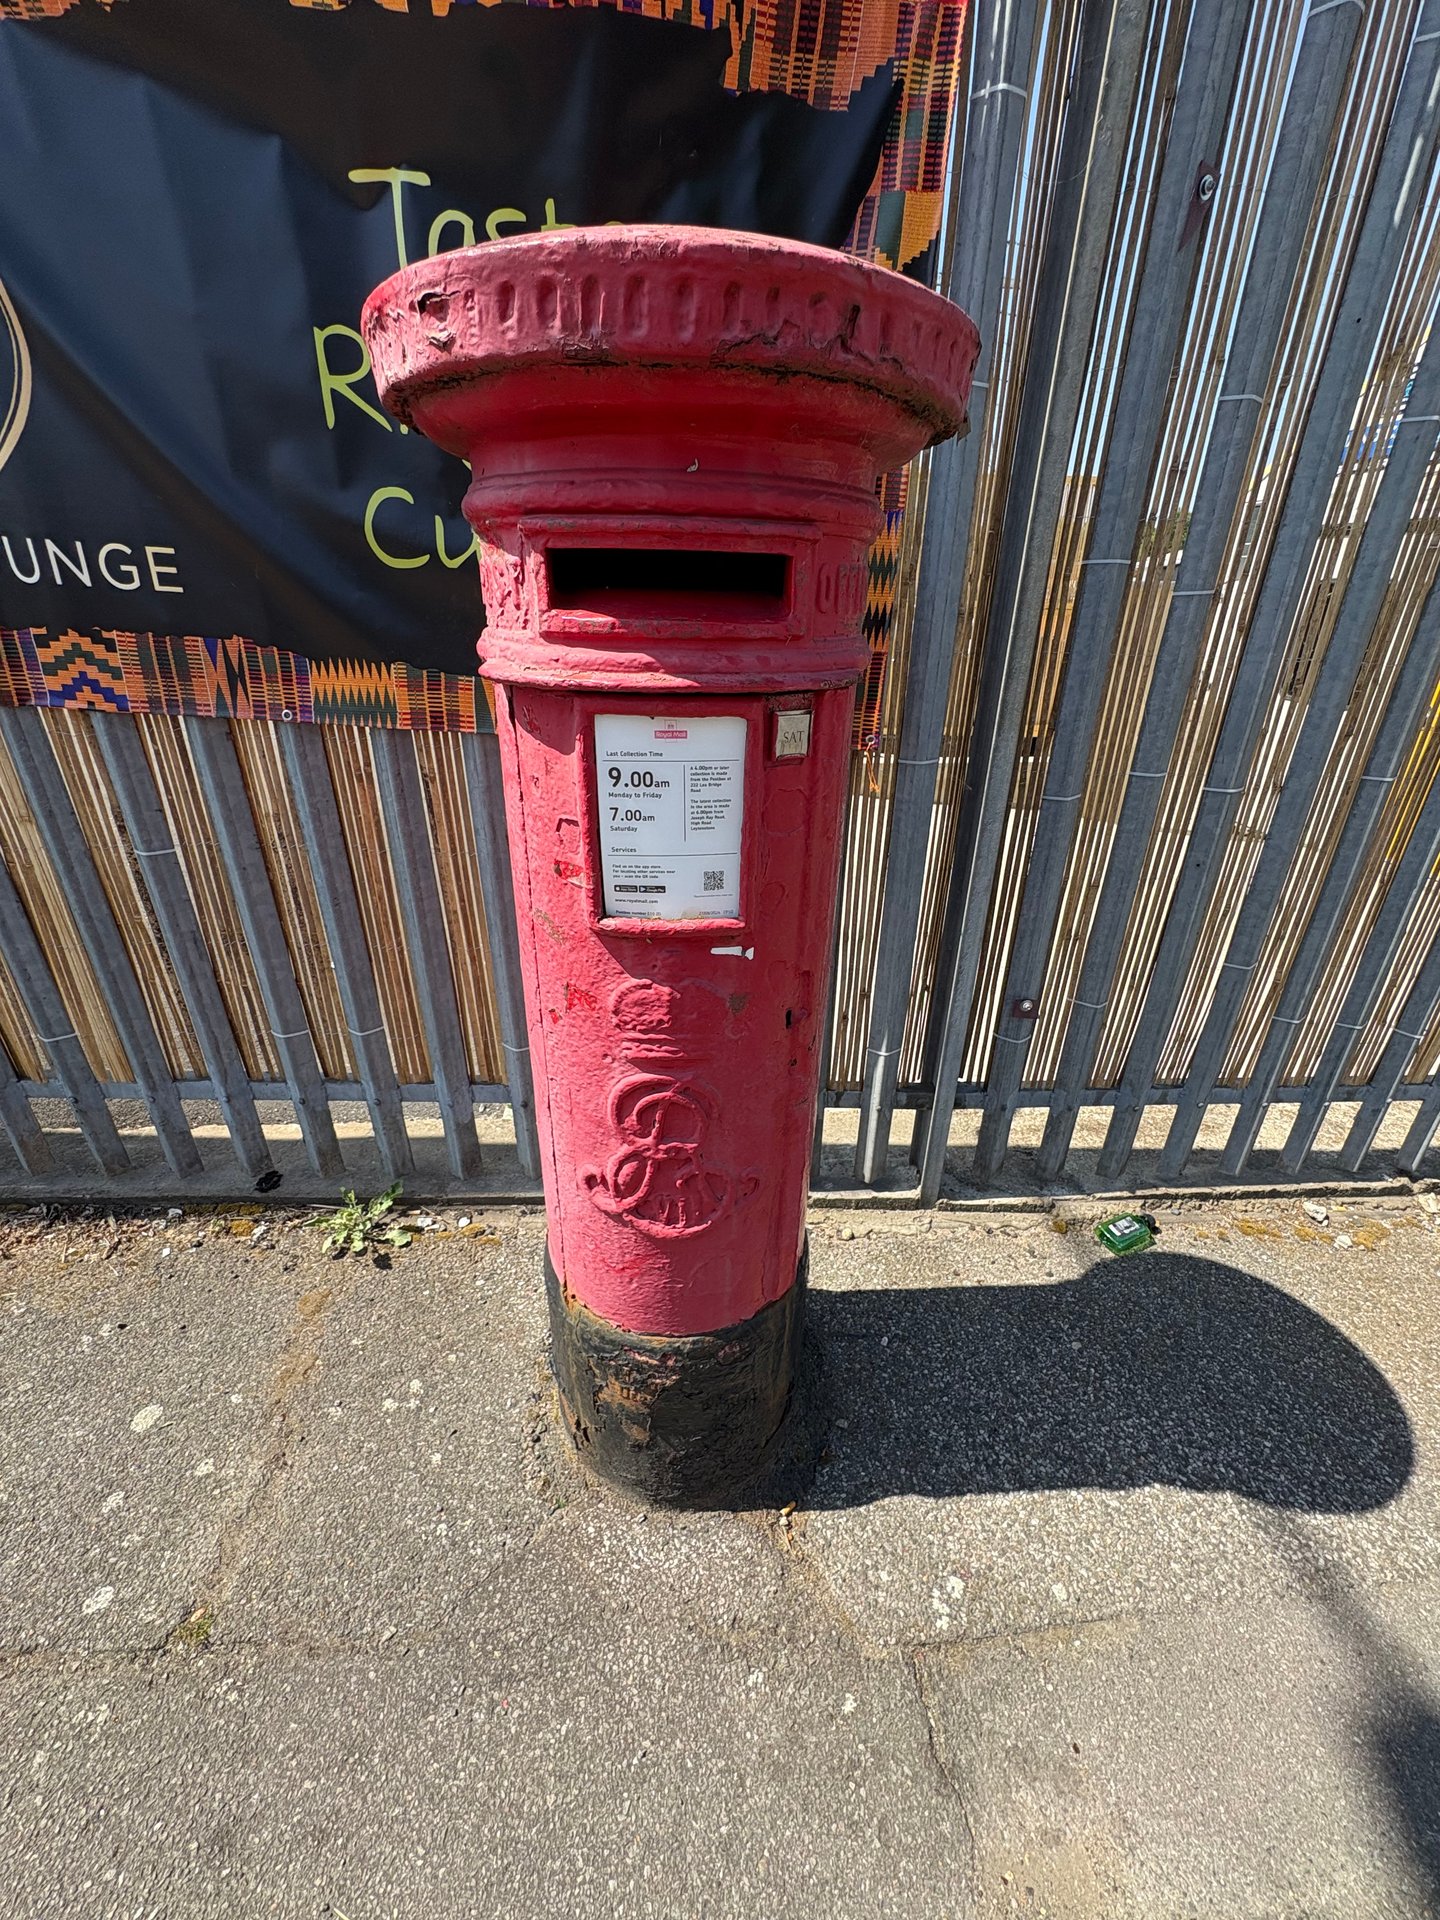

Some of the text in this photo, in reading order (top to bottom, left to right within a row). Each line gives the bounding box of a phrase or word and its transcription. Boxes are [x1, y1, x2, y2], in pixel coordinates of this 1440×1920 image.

[348, 167, 624, 269] Tast
[1, 535, 184, 593] UNGE
[784, 730, 804, 743] SAT
[608, 767, 670, 788] 9.00am
[609, 807, 655, 821] 7.00am
